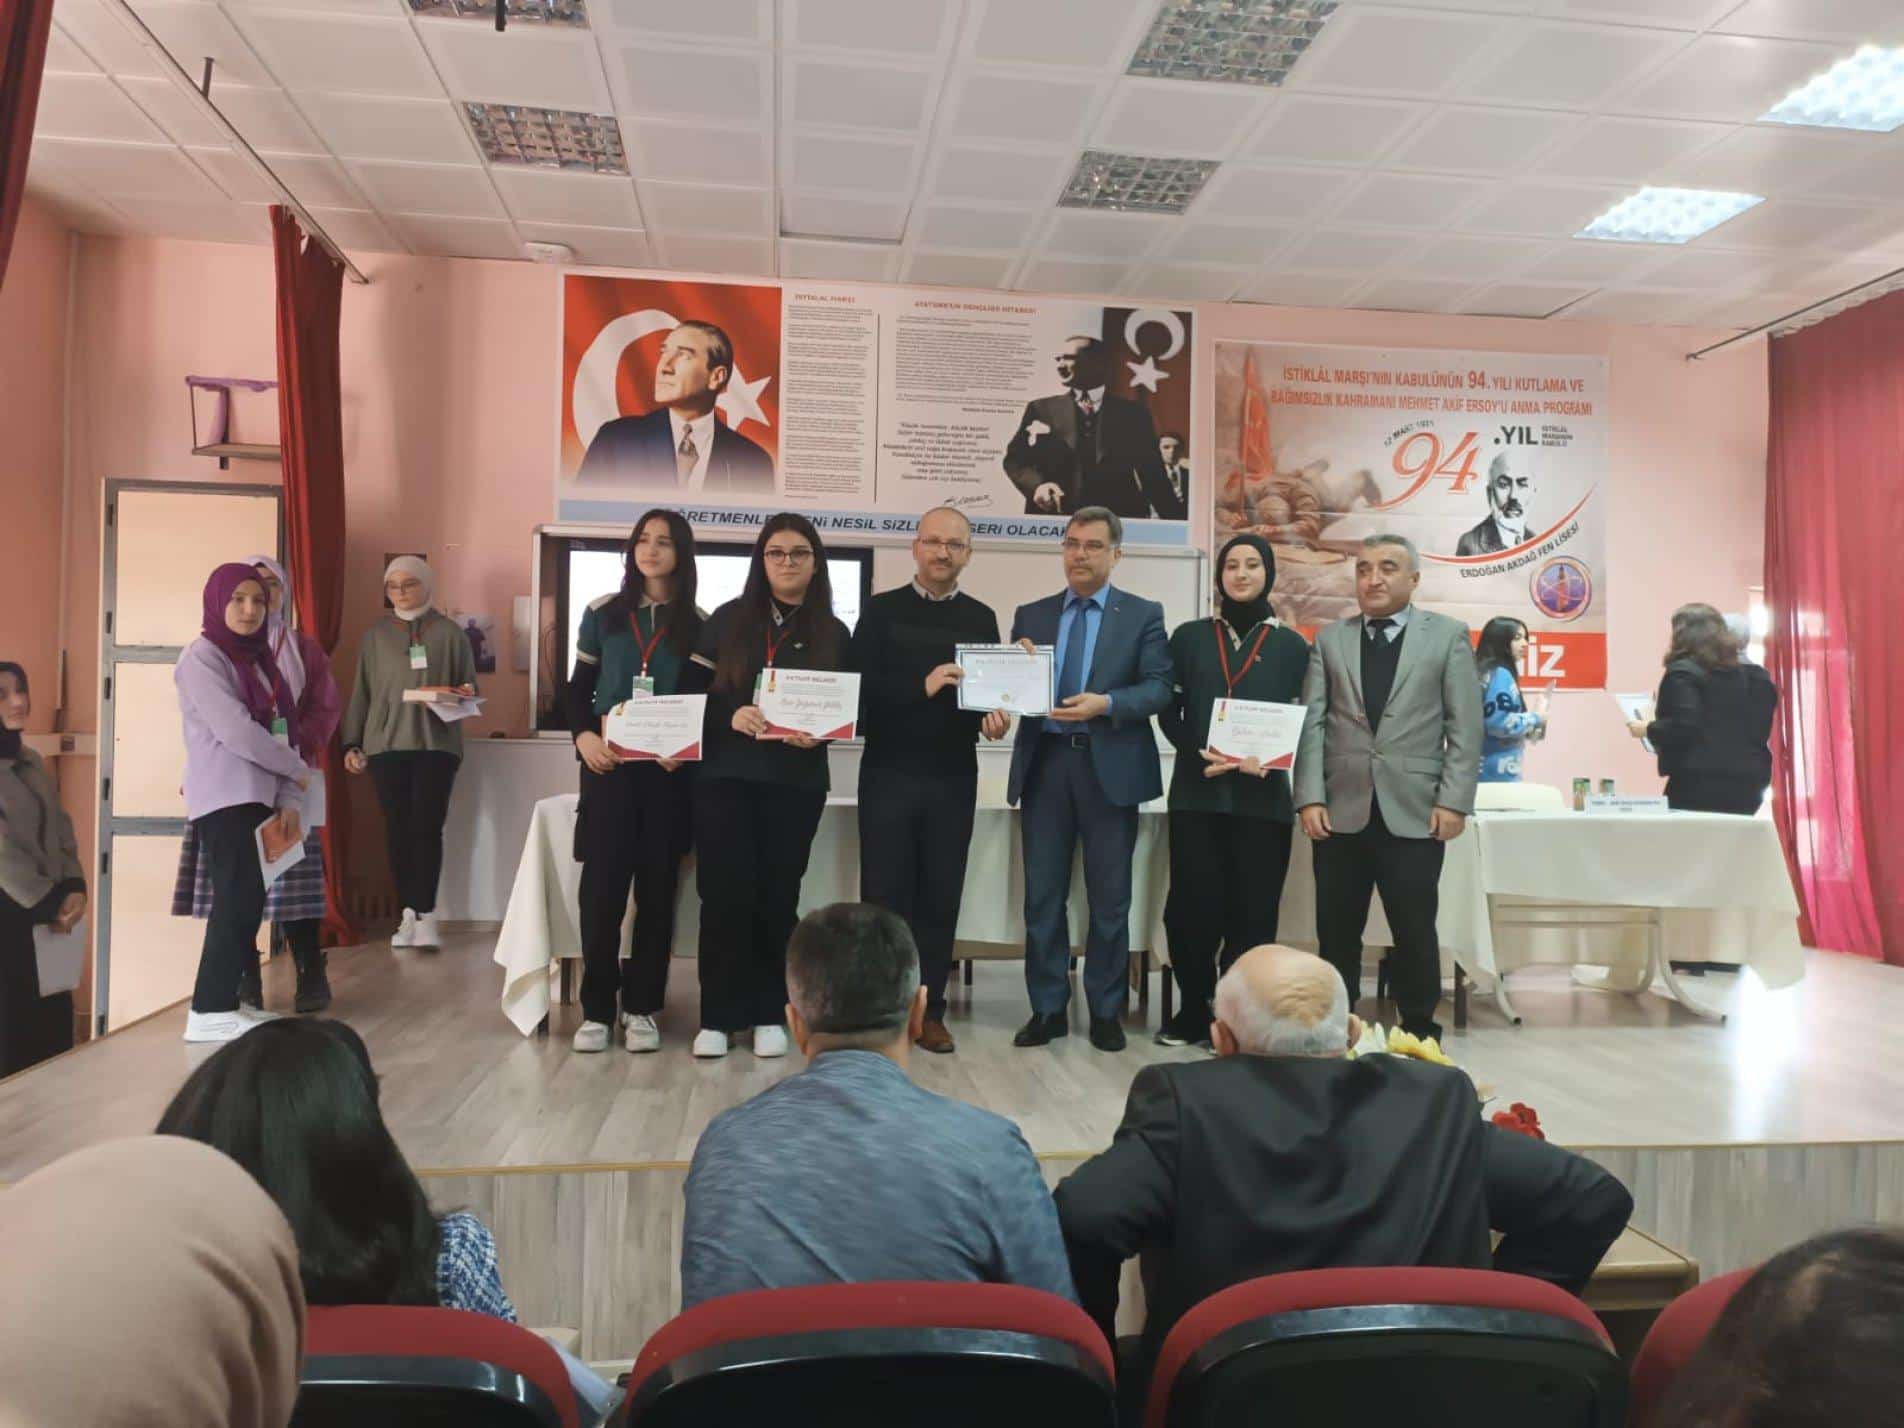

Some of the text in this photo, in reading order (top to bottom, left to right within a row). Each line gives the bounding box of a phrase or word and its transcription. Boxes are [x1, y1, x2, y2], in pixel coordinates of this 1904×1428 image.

[1468, 371, 1490, 389] 94.
[1493, 376, 1512, 391] YILI
[1515, 377, 1567, 392] KUTLAMA
[1570, 379, 1584, 392] VE
[1398, 395, 1441, 409] MEHMET
[1466, 398, 1507, 413] ERSOY'U
[1510, 400, 1540, 414] ANMA
[1543, 401, 1592, 416] PROGRAMI
[1377, 431, 1480, 509] 94
[1459, 564, 1505, 578] ERDOĞAN
[1507, 552, 1537, 571] AKDAĞ
[1538, 543, 1554, 557] FEN
